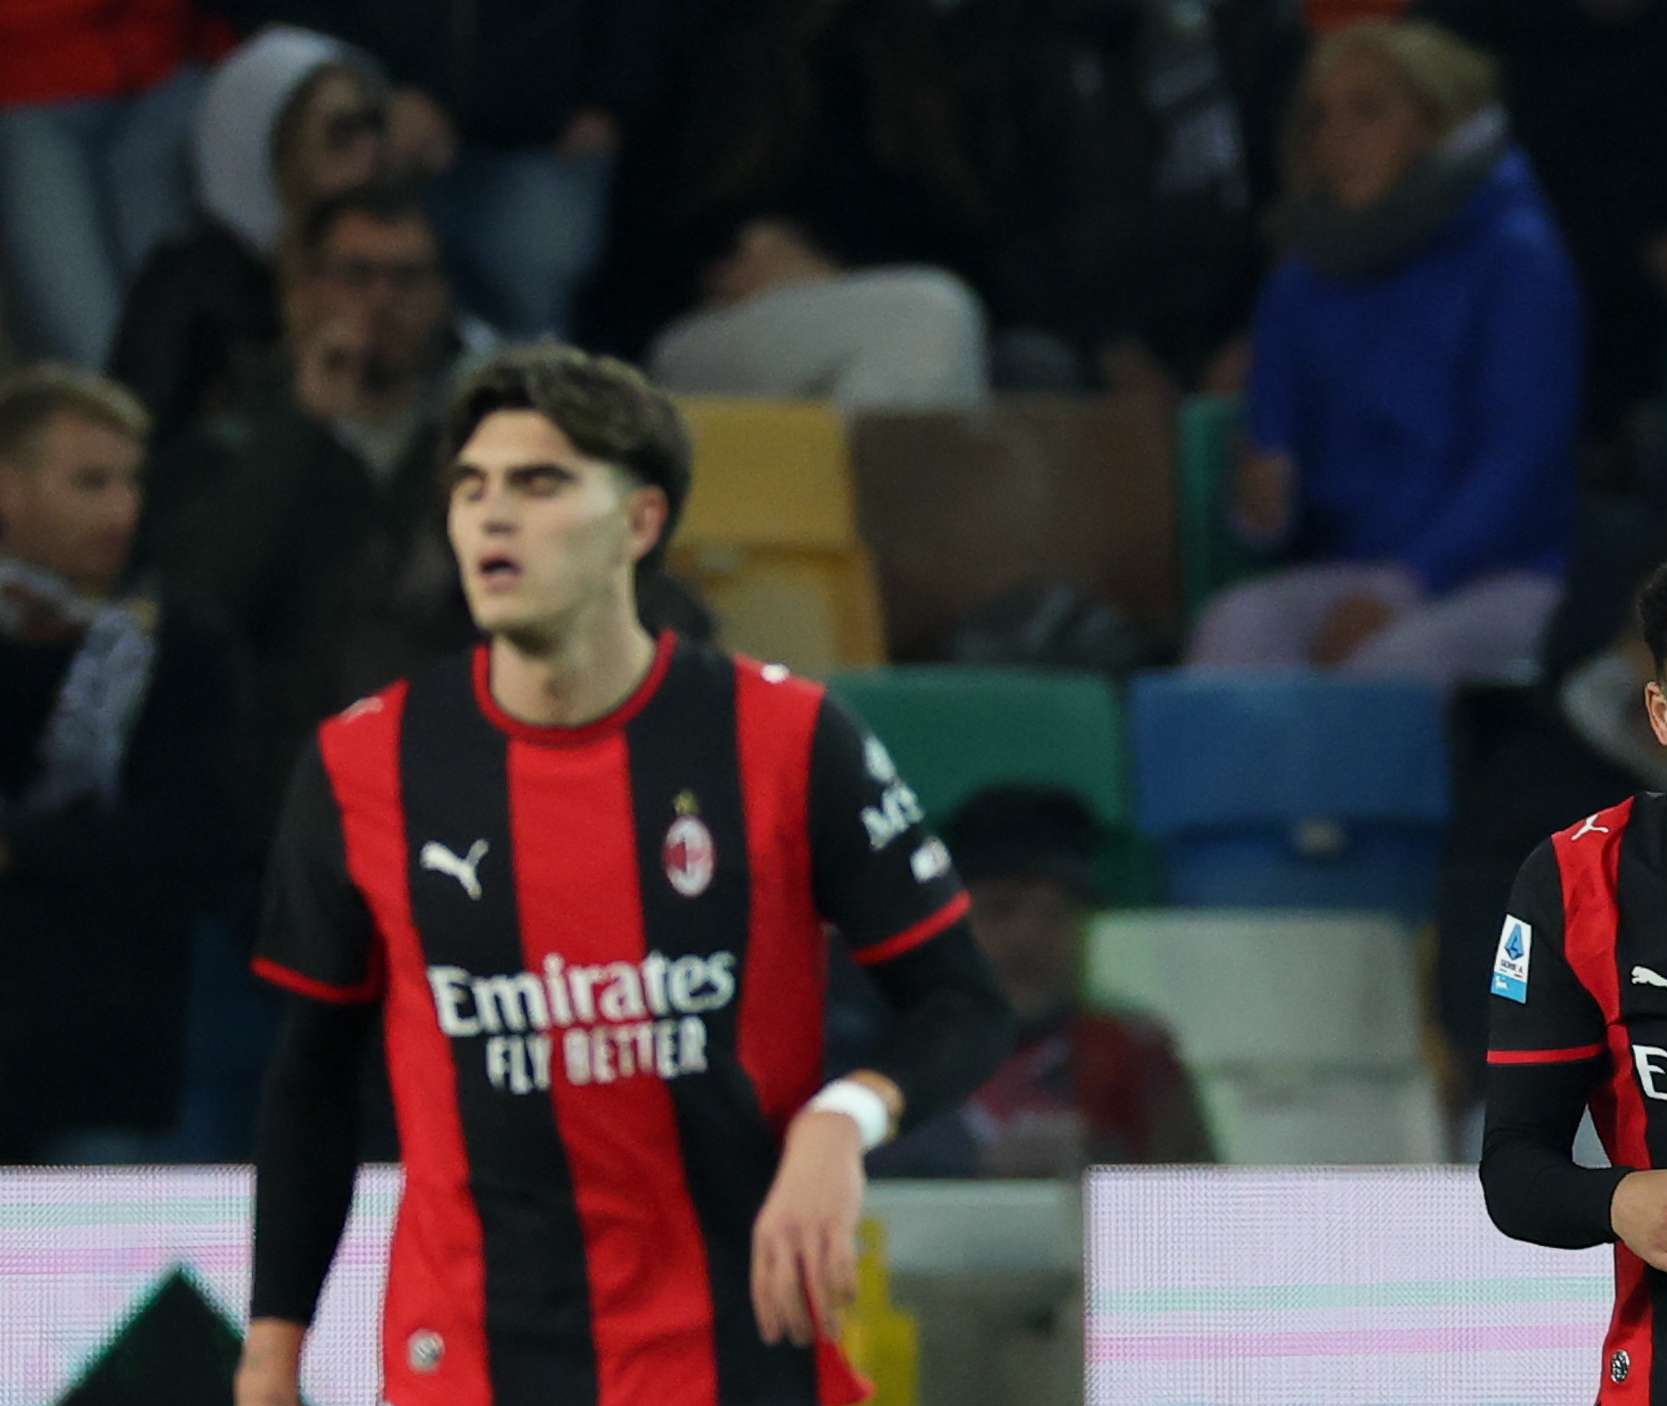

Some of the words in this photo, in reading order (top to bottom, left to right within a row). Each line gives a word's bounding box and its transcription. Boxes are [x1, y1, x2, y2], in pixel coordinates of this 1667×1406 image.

[426, 950, 737, 1037] Emirates
[486, 1034, 553, 1094] FLY
[563, 1015, 708, 1086] BETTER
